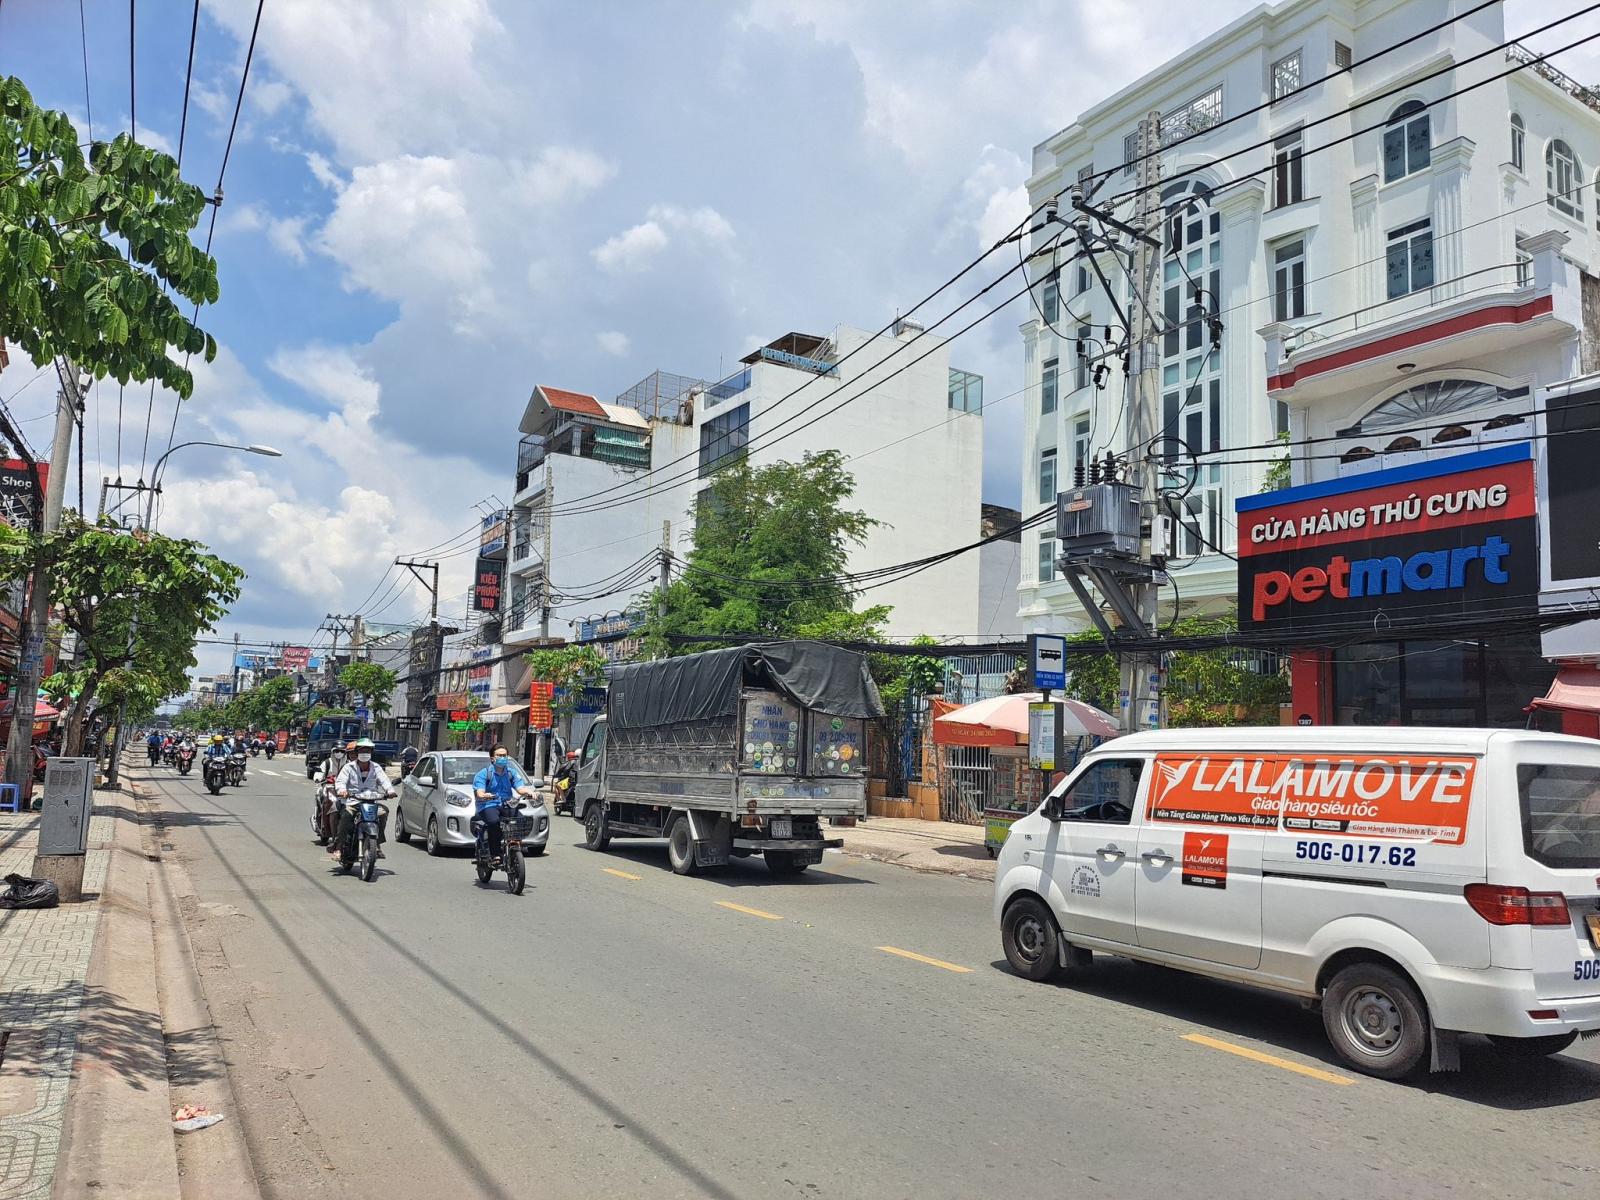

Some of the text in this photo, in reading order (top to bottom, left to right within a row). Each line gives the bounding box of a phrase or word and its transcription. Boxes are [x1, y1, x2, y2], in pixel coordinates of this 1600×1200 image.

[3, 476, 32, 490] Shop
[1251, 484, 1508, 543] CỬA HÀNG THÚ CƯNG
[1252, 535, 1509, 621] petmart
[1192, 757, 1471, 803] LALAMOVE
[1251, 797, 1378, 817] Giao hàng siêu tốc
[1185, 812, 1201, 820] Giao
[1201, 812, 1218, 823] Hàng
[1220, 814, 1237, 823] Theo
[1238, 814, 1251, 823] Yêu
[1352, 825, 1367, 833] Giao
[1368, 825, 1384, 835] Hàng
[1397, 827, 1420, 836] Thành
[1184, 855, 1225, 865] LALAMOVE
[1296, 841, 1416, 867] 50G-017.62
